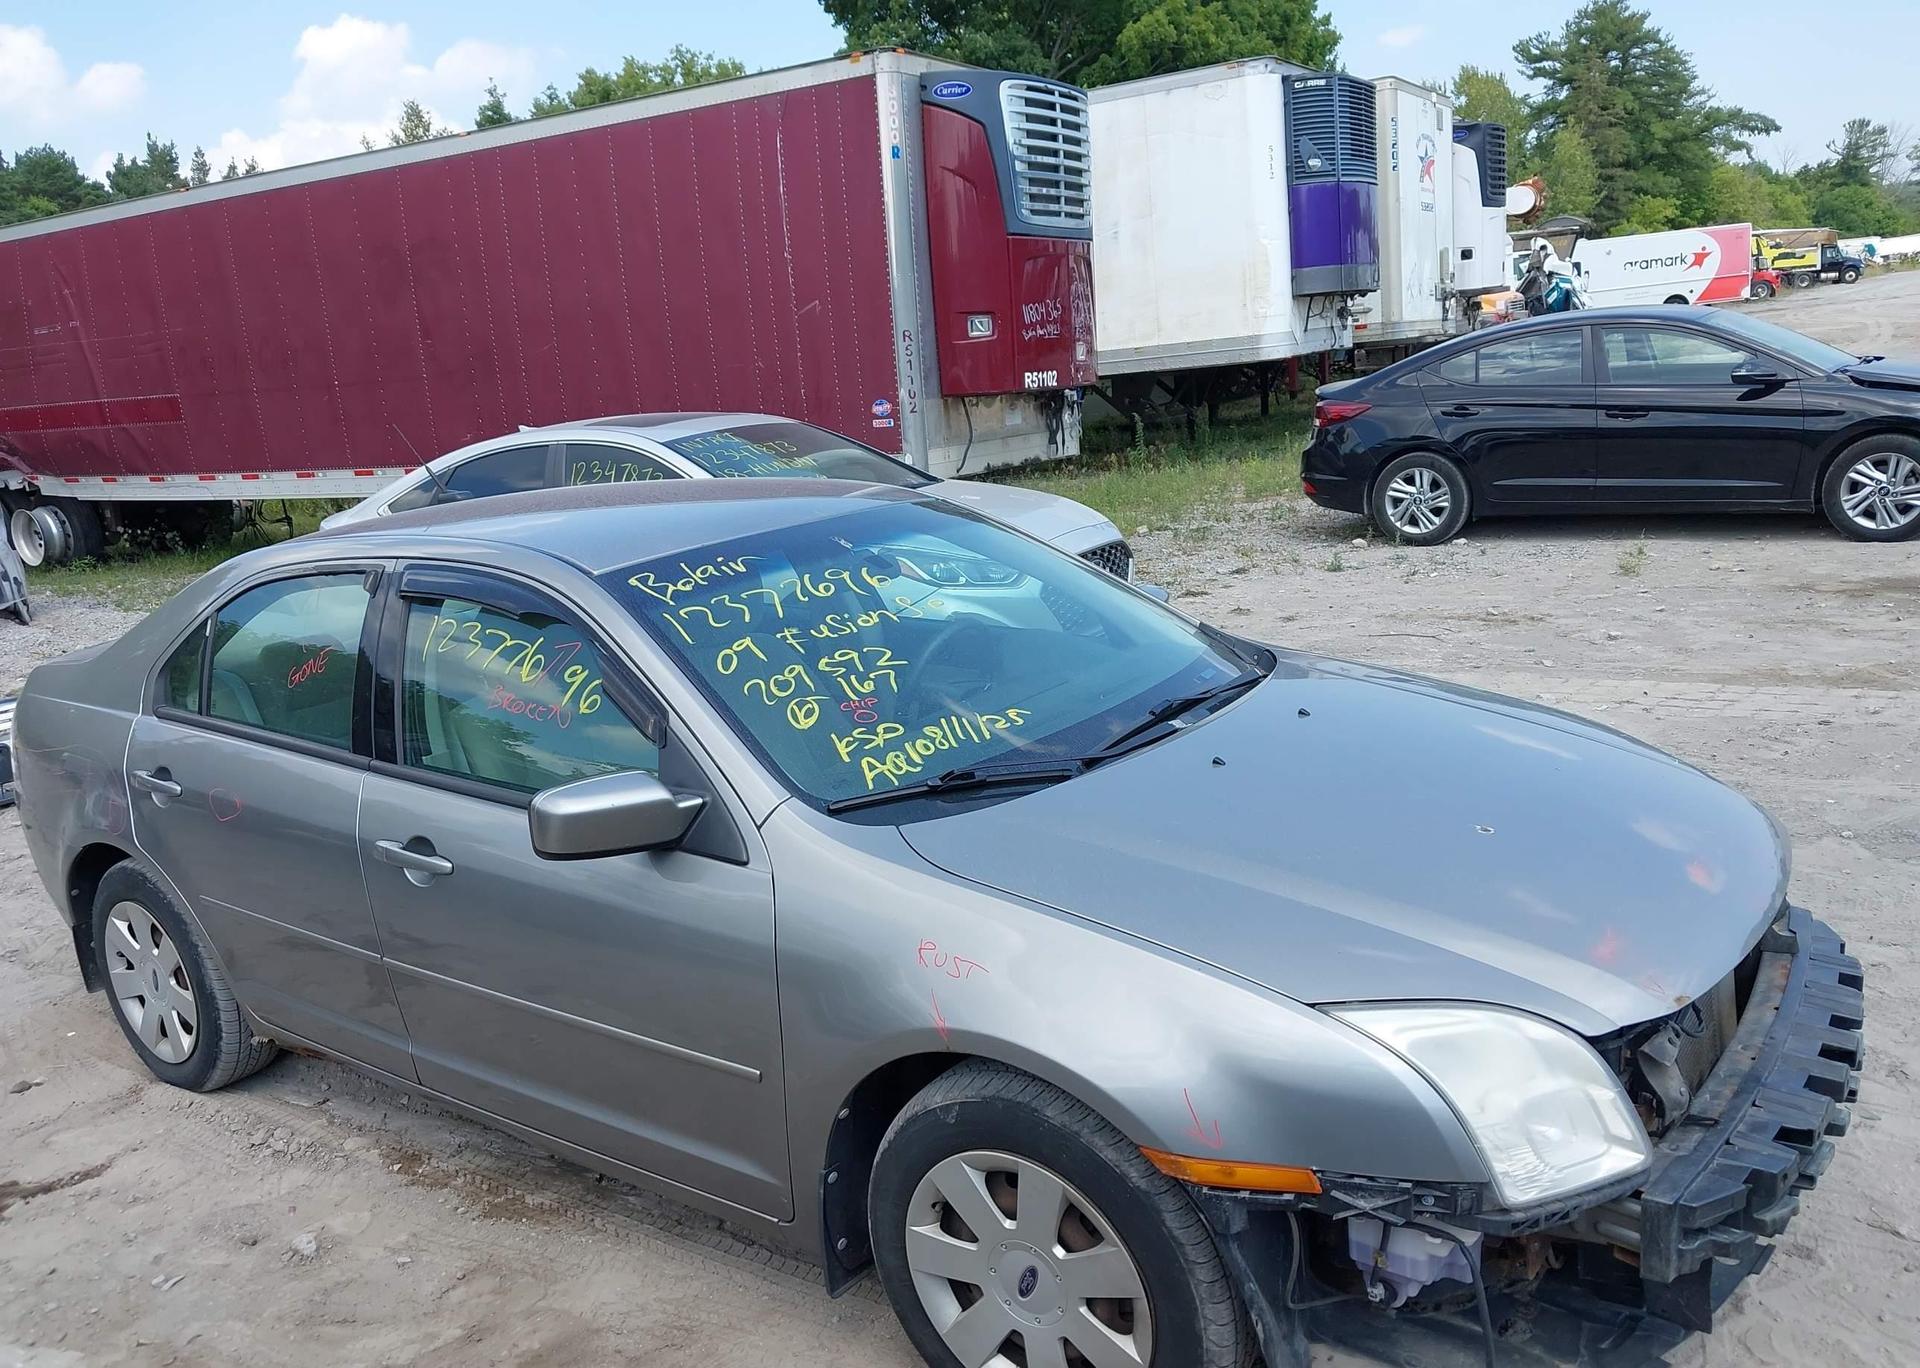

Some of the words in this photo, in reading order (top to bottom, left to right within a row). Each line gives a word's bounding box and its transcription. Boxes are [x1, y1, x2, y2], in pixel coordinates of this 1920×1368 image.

[937, 85, 967, 95] Carrier
[1624, 252, 1688, 271] aramark
[1024, 370, 1058, 389] R51102
[691, 440, 797, 468] 12347873
[662, 567, 892, 644] 12377696
[717, 636, 768, 675] 09
[776, 609, 900, 655] Fusion
[287, 647, 333, 689] GONE
[743, 664, 816, 706] 209
[837, 669, 899, 701] 167
[840, 697, 879, 712] CHIP
[918, 938, 990, 979] RUST
